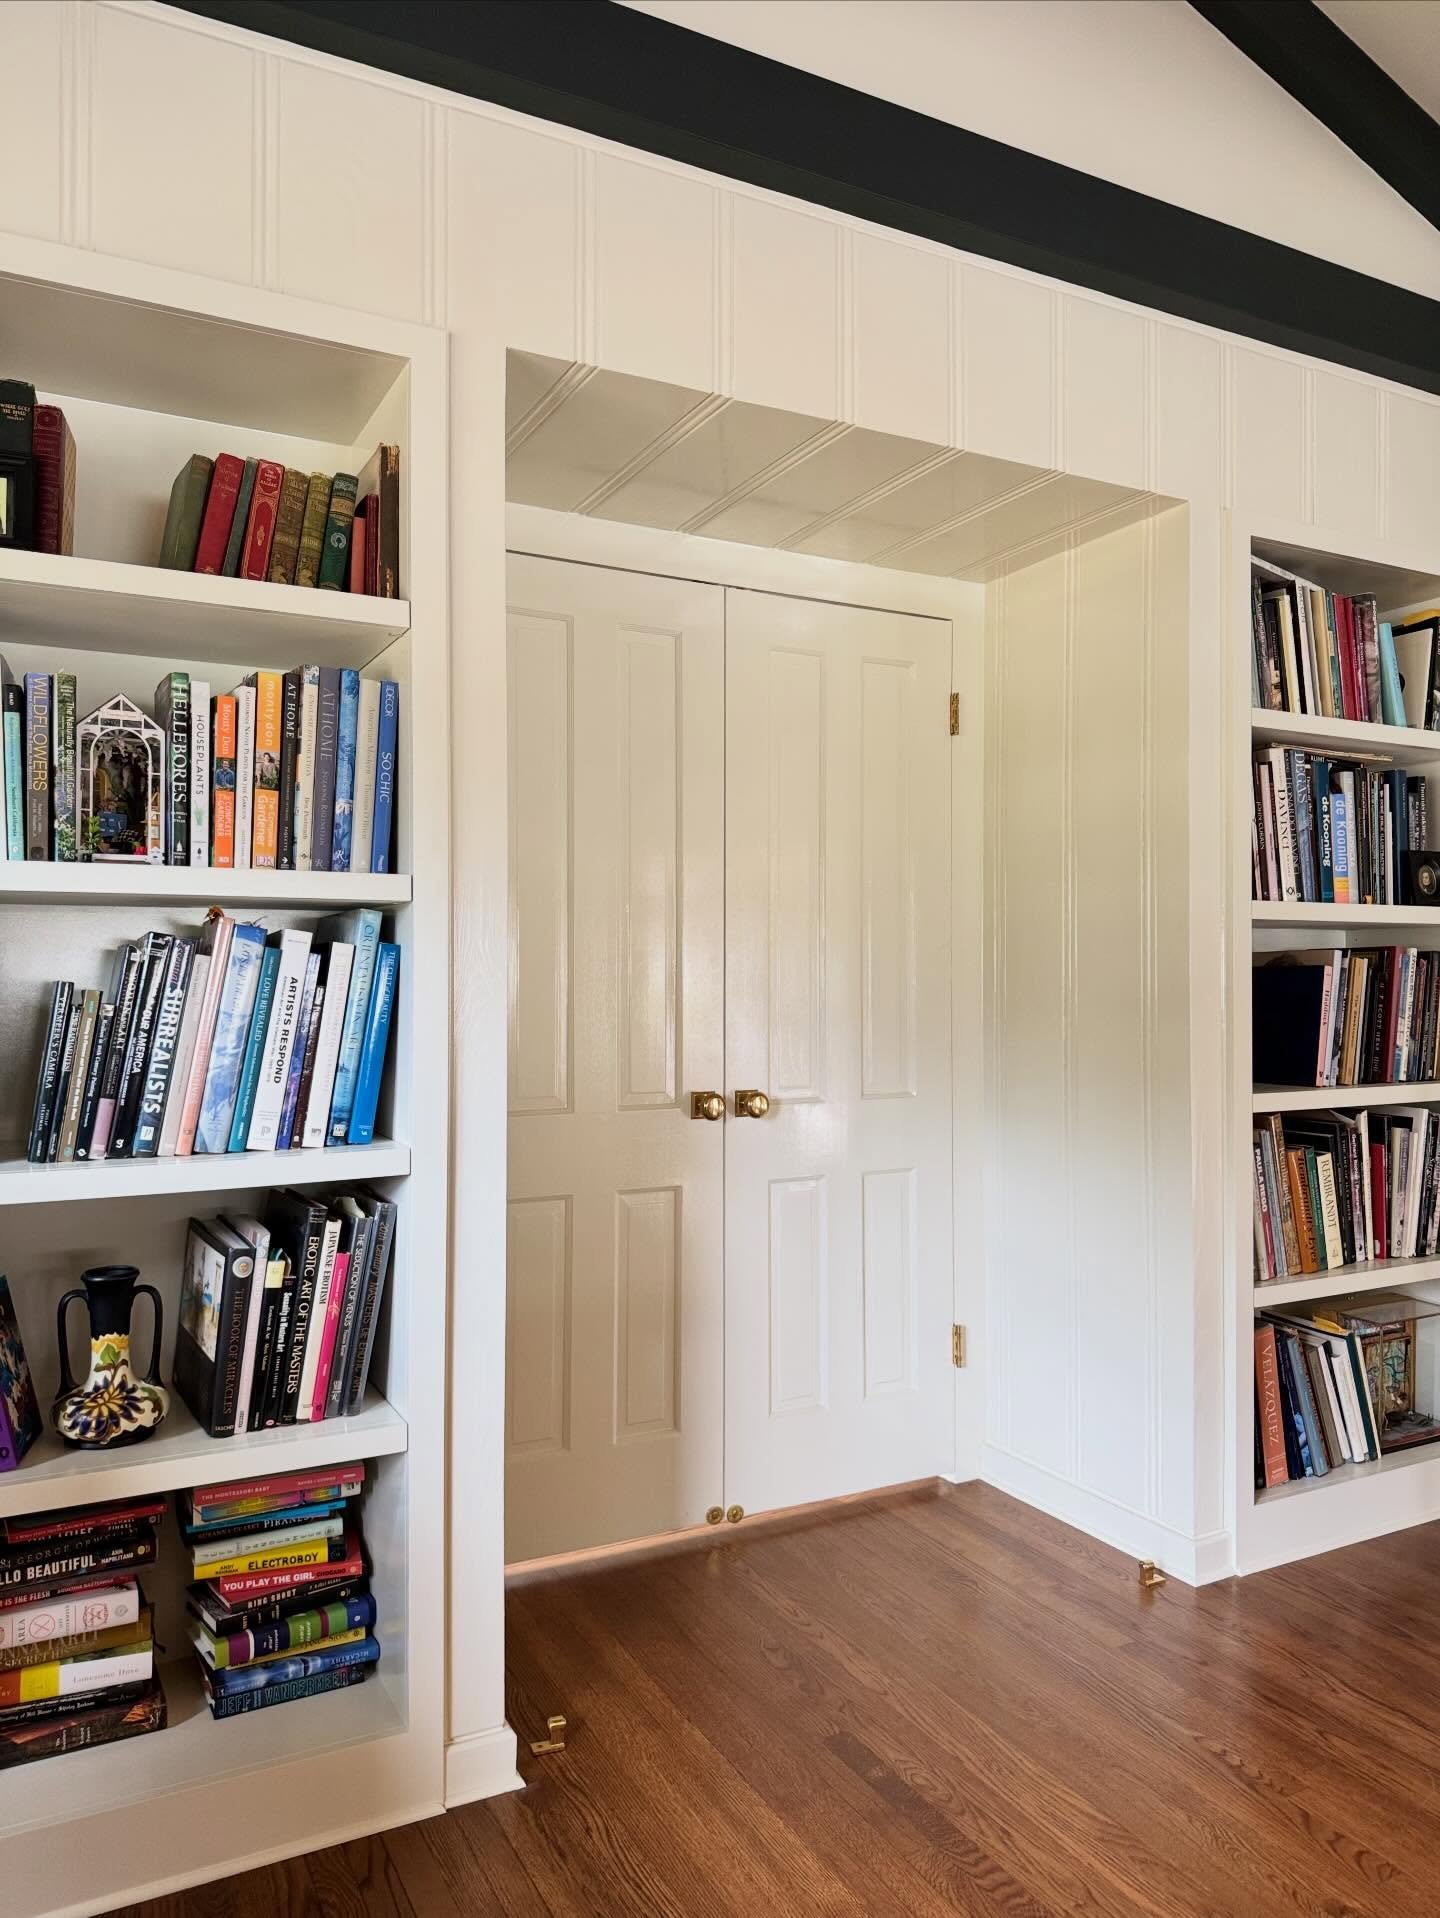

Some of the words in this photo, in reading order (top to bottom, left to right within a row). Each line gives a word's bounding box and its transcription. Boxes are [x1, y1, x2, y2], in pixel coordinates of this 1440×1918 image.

[287, 683, 297, 699] AT
[323, 687, 335, 711] AT
[66, 702, 75, 716] The
[223, 704, 232, 733] Monty
[285, 703, 296, 738] HOME
[32, 676, 48, 791] WILDFLOWERS
[65, 717, 75, 747] Naturally
[173, 682, 188, 803] HELLEBORES
[223, 736, 231, 755] Don
[320, 711, 335, 761] HOME
[65, 749, 75, 781] Beautiful
[195, 714, 205, 796] HOUSEPLANTS
[381, 751, 392, 770] SO
[379, 772, 391, 804] CHIC
[1294, 751, 1307, 803] DEGAS
[66, 782, 75, 808] Garden
[1321, 796, 1329, 812] de
[1335, 799, 1346, 815] de
[257, 795, 268, 847] Gardener
[1322, 813, 1332, 867] Kooning
[1334, 820, 1348, 872] Kooning
[261, 977, 272, 999] LOVE
[283, 977, 299, 1026] ARTISTS
[51, 996, 66, 1048] VERMEER'S
[140, 1010, 151, 1029] OUR
[254, 1000, 269, 1041] REVEALED
[379, 993, 391, 1024] BEAUTY
[115, 1029, 127, 1050] ART
[131, 1031, 148, 1074] AMERICA
[143, 988, 183, 1114] SURREALISTS
[44, 1050, 58, 1090] CAMERA
[273, 1029, 290, 1084] RESPOND
[1254, 1148, 1267, 1184] PAULA
[1279, 1147, 1292, 1206] Rembrandt
[1259, 1184, 1268, 1213] REGO
[1320, 1158, 1337, 1230] REMBRANDT
[1296, 1156, 1313, 1233] Rembrandt's
[1308, 1237, 1319, 1264] Eyes
[355, 1233, 366, 1246] THE
[377, 1222, 390, 1240] 20th
[304, 1236, 320, 1276] EROTIC
[324, 1230, 338, 1268] JAPANESE
[370, 1244, 385, 1276] Century
[349, 1247, 364, 1289] SEDUCTION
[233, 1287, 245, 1311] THE
[299, 1279, 317, 1301] ART
[318, 1270, 332, 1305] EROTISM
[347, 1290, 358, 1302] OF
[279, 1292, 293, 1316] Sexuality
[296, 1302, 310, 1319] OF
[343, 1301, 356, 1327] VENUS
[362, 1281, 379, 1324] MASTERS
[229, 1313, 242, 1345] BOOK
[277, 1322, 288, 1343] Western
[294, 1321, 308, 1343] THE
[361, 1328, 373, 1338] OF
[228, 1346, 240, 1359] OF
[275, 1343, 285, 1353] Art
[353, 1342, 370, 1372] EROTIC
[286, 1345, 302, 1394] MASTERS
[351, 1374, 362, 1392] ART
[222, 1361, 238, 1414] MIRACLES
[215, 1489, 253, 1500] MONTESSORI
[254, 1485, 270, 1493] BABY
[263, 1516, 315, 1529] PIRANES
[101, 1553, 134, 1564] NAPOLITANO
[111, 1548, 124, 1556] ANN
[247, 1552, 319, 1571] ELECTROBOY
[27, 1555, 97, 1580] BEAUTIFUL
[223, 1581, 244, 1592] YOU
[246, 1578, 270, 1589] PLAY
[272, 1575, 292, 1585] THE
[293, 1571, 315, 1582] GIRL
[5, 1598, 13, 1606] IS
[14, 1594, 28, 1605] THE
[29, 1590, 50, 1601] FLESH
[247, 1595, 267, 1609] RING
[271, 1588, 297, 1603] SHOUT
[73, 1671, 115, 1684] Lonesome
[118, 1668, 139, 1677] Dove
[219, 1692, 250, 1715] JEFF
[263, 1674, 349, 1705] VANDERMEER
